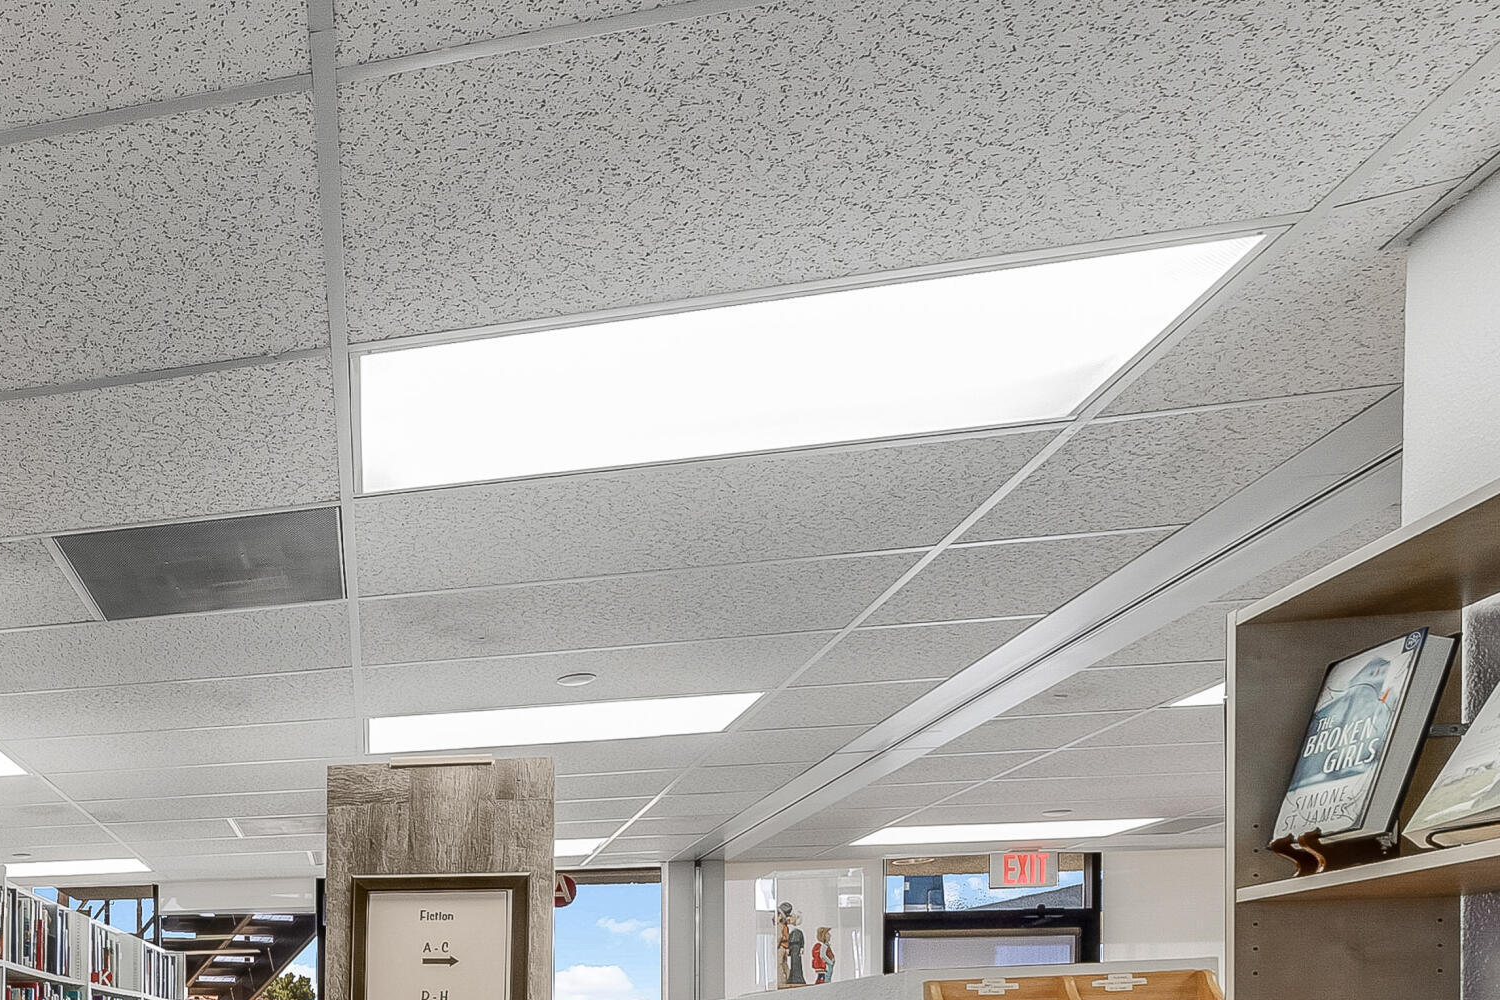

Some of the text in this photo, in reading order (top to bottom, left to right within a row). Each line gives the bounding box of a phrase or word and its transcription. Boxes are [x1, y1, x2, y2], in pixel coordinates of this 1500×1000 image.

[1317, 716, 1334, 732] THE
[1303, 716, 1377, 758] BROKEN
[1323, 737, 1380, 774] GIRLS
[1295, 785, 1348, 810] SIMONE
[1282, 803, 1348, 831] ST. JAMES
[1003, 853, 1049, 884] EXIT
[554, 873, 572, 902] A
[419, 910, 454, 921] Fiction
[423, 942, 431, 953] A
[441, 942, 450, 953] C
[99, 970, 111, 988] K
[421, 991, 430, 1000] D
[440, 991, 449, 1000] H
